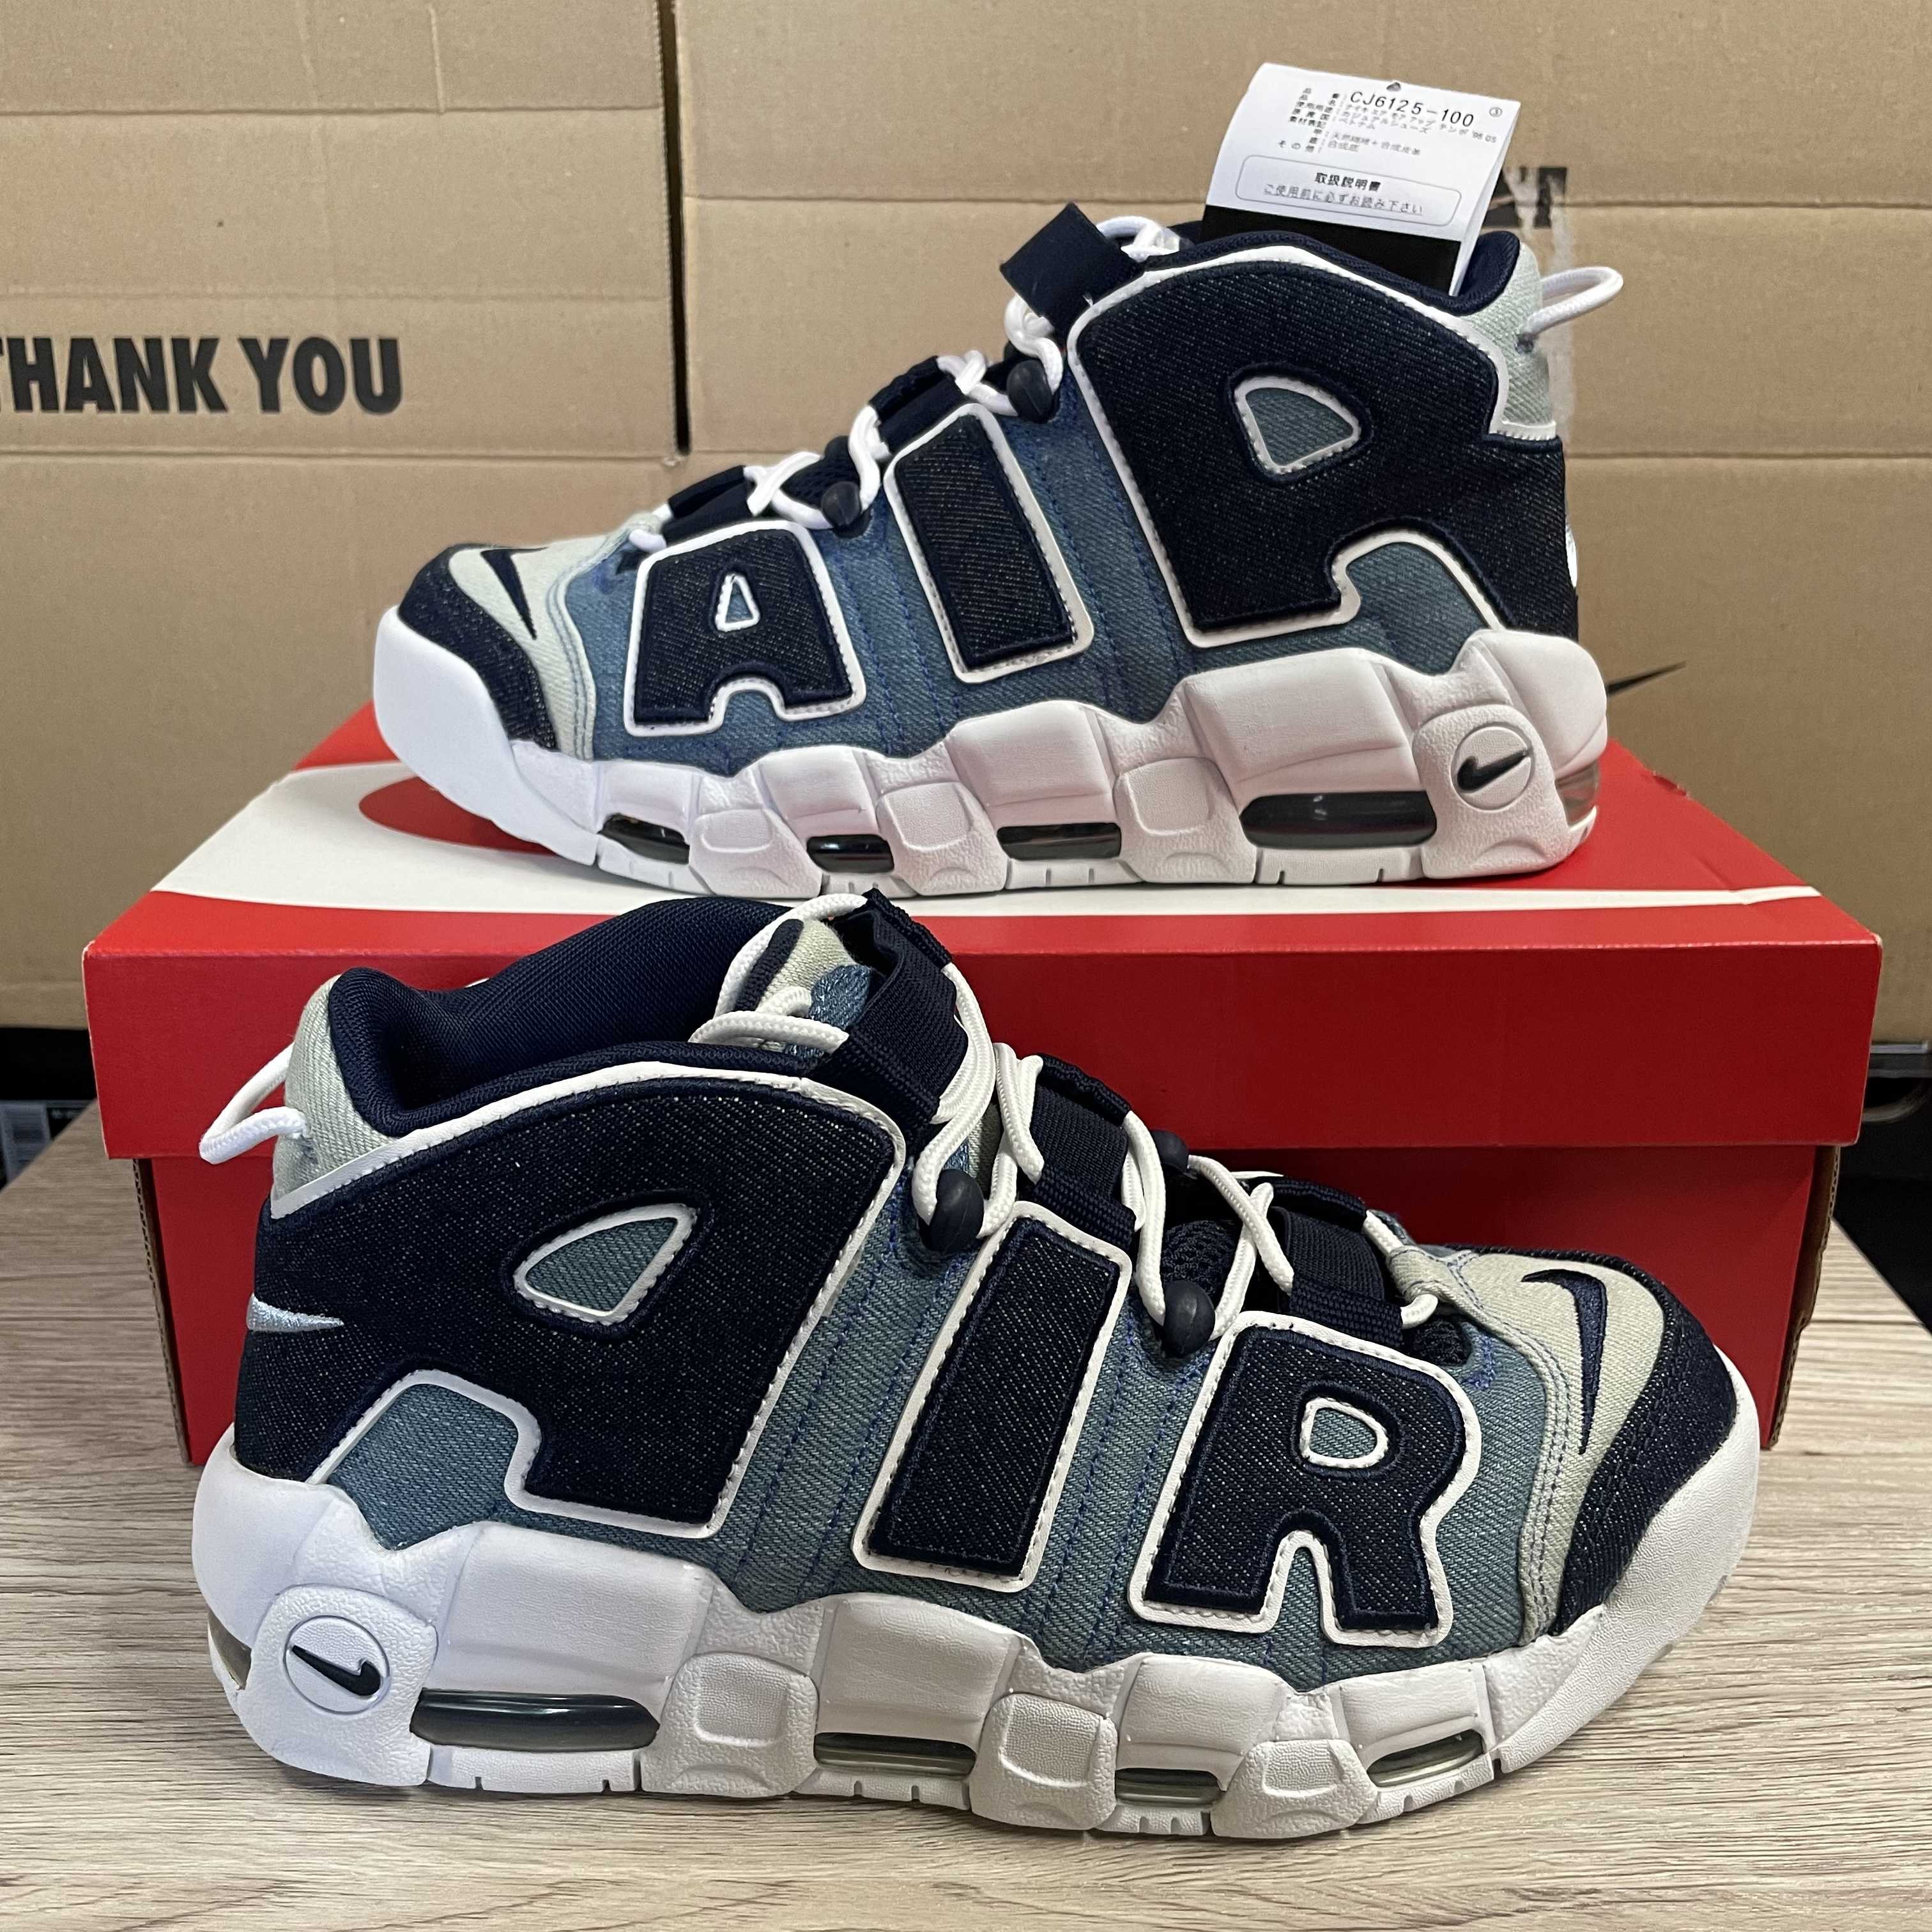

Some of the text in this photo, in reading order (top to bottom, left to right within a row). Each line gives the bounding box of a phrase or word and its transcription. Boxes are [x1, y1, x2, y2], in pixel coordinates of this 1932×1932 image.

[1349, 91, 1475, 128] CJ6125-100
[0, 336, 402, 415] HANK YOU
